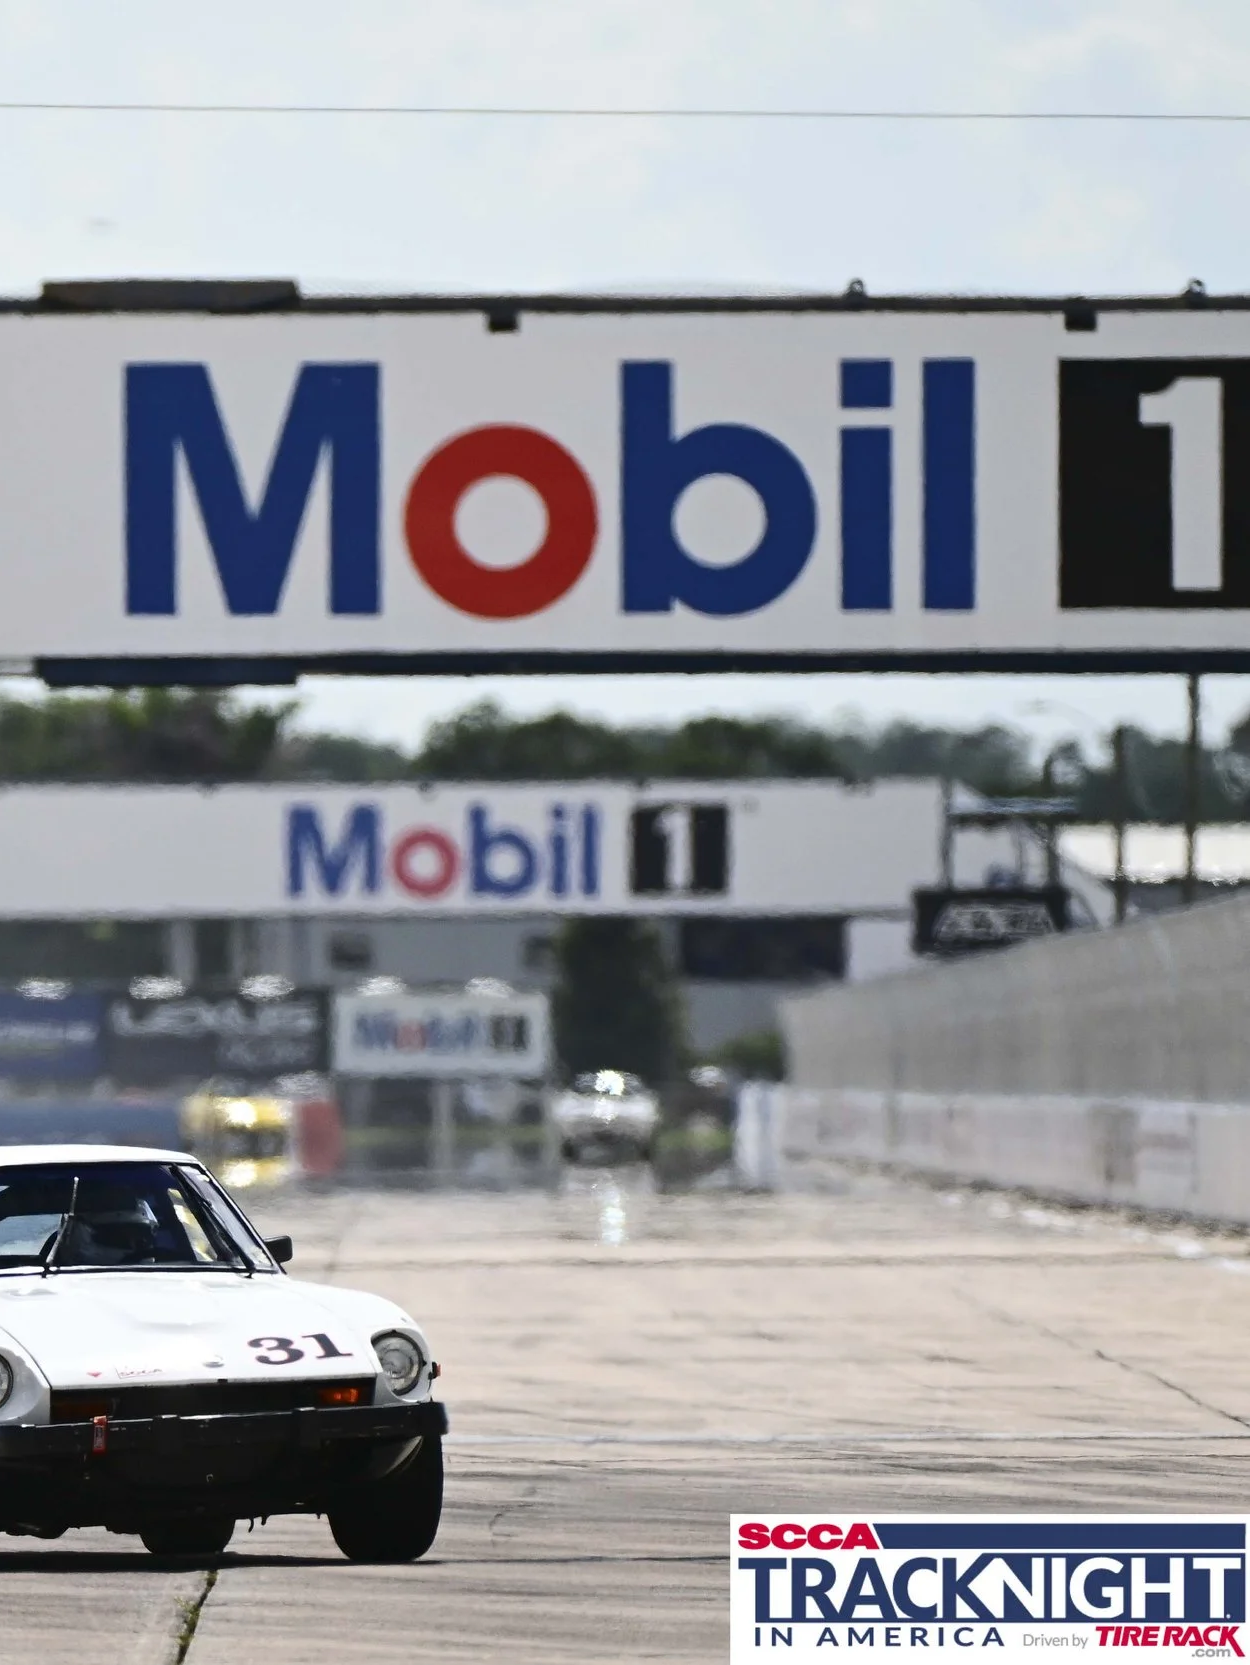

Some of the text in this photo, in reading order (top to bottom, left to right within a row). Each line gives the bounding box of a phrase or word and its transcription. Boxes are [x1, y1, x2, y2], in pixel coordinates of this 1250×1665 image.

[124, 357, 976, 619] Mobil
[286, 803, 600, 898] Mobil
[246, 1333, 352, 1365] 31
